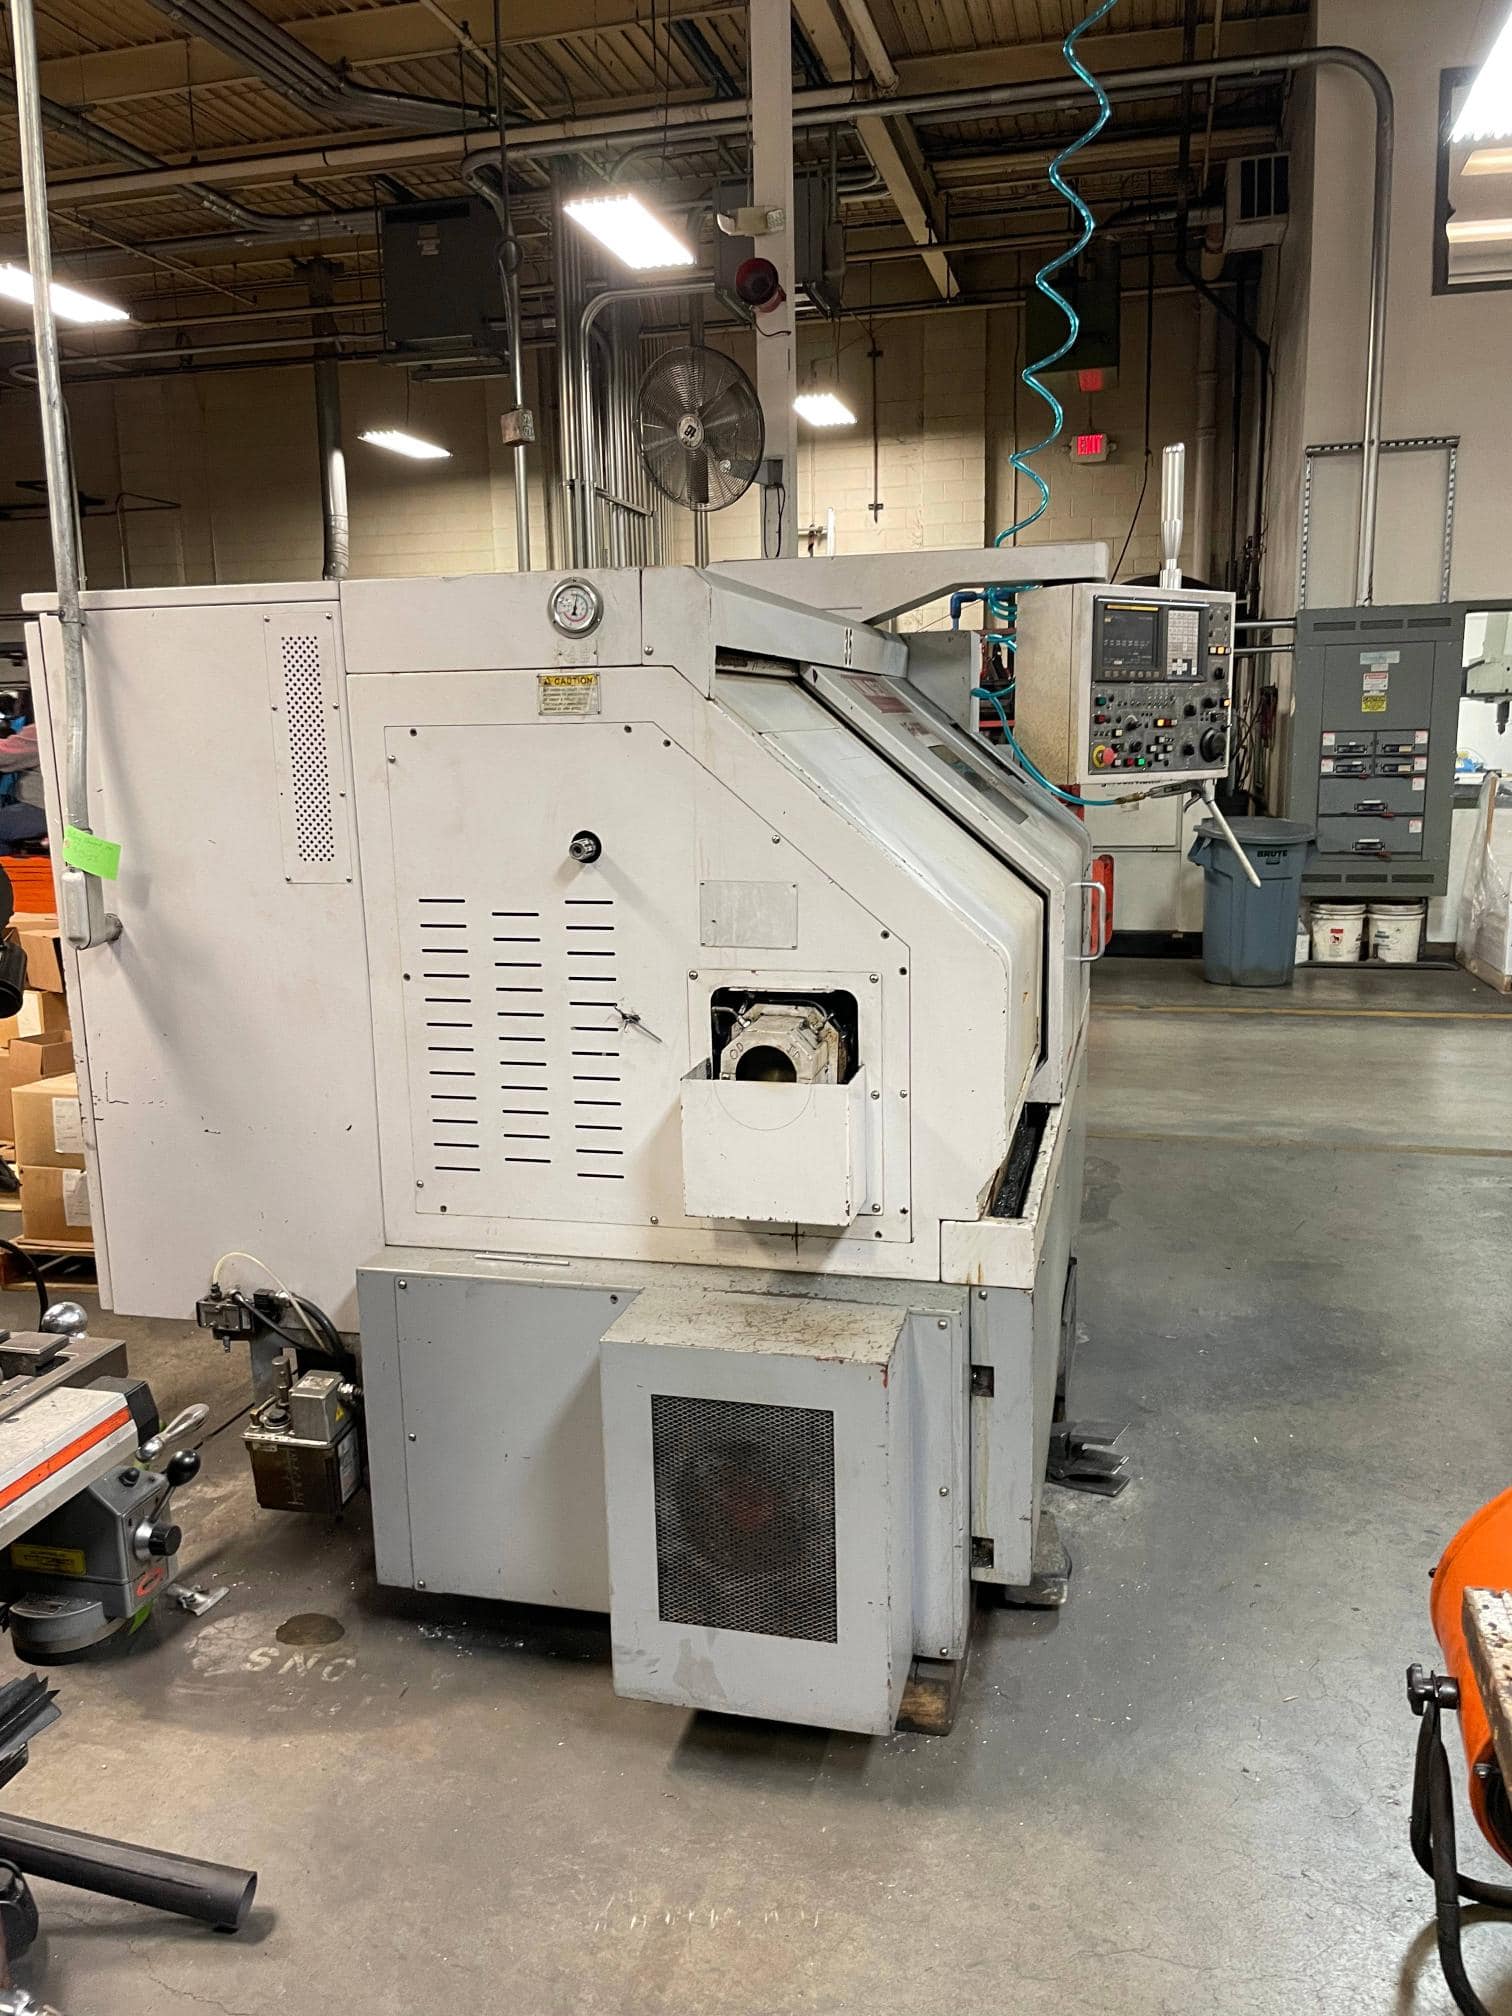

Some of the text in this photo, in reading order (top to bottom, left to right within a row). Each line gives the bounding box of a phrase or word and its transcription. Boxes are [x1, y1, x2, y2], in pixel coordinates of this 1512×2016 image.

[1078, 435, 1103, 455] EXIT
[554, 677, 593, 685] CAUTION
[1257, 849, 1287, 857] BRUTE
